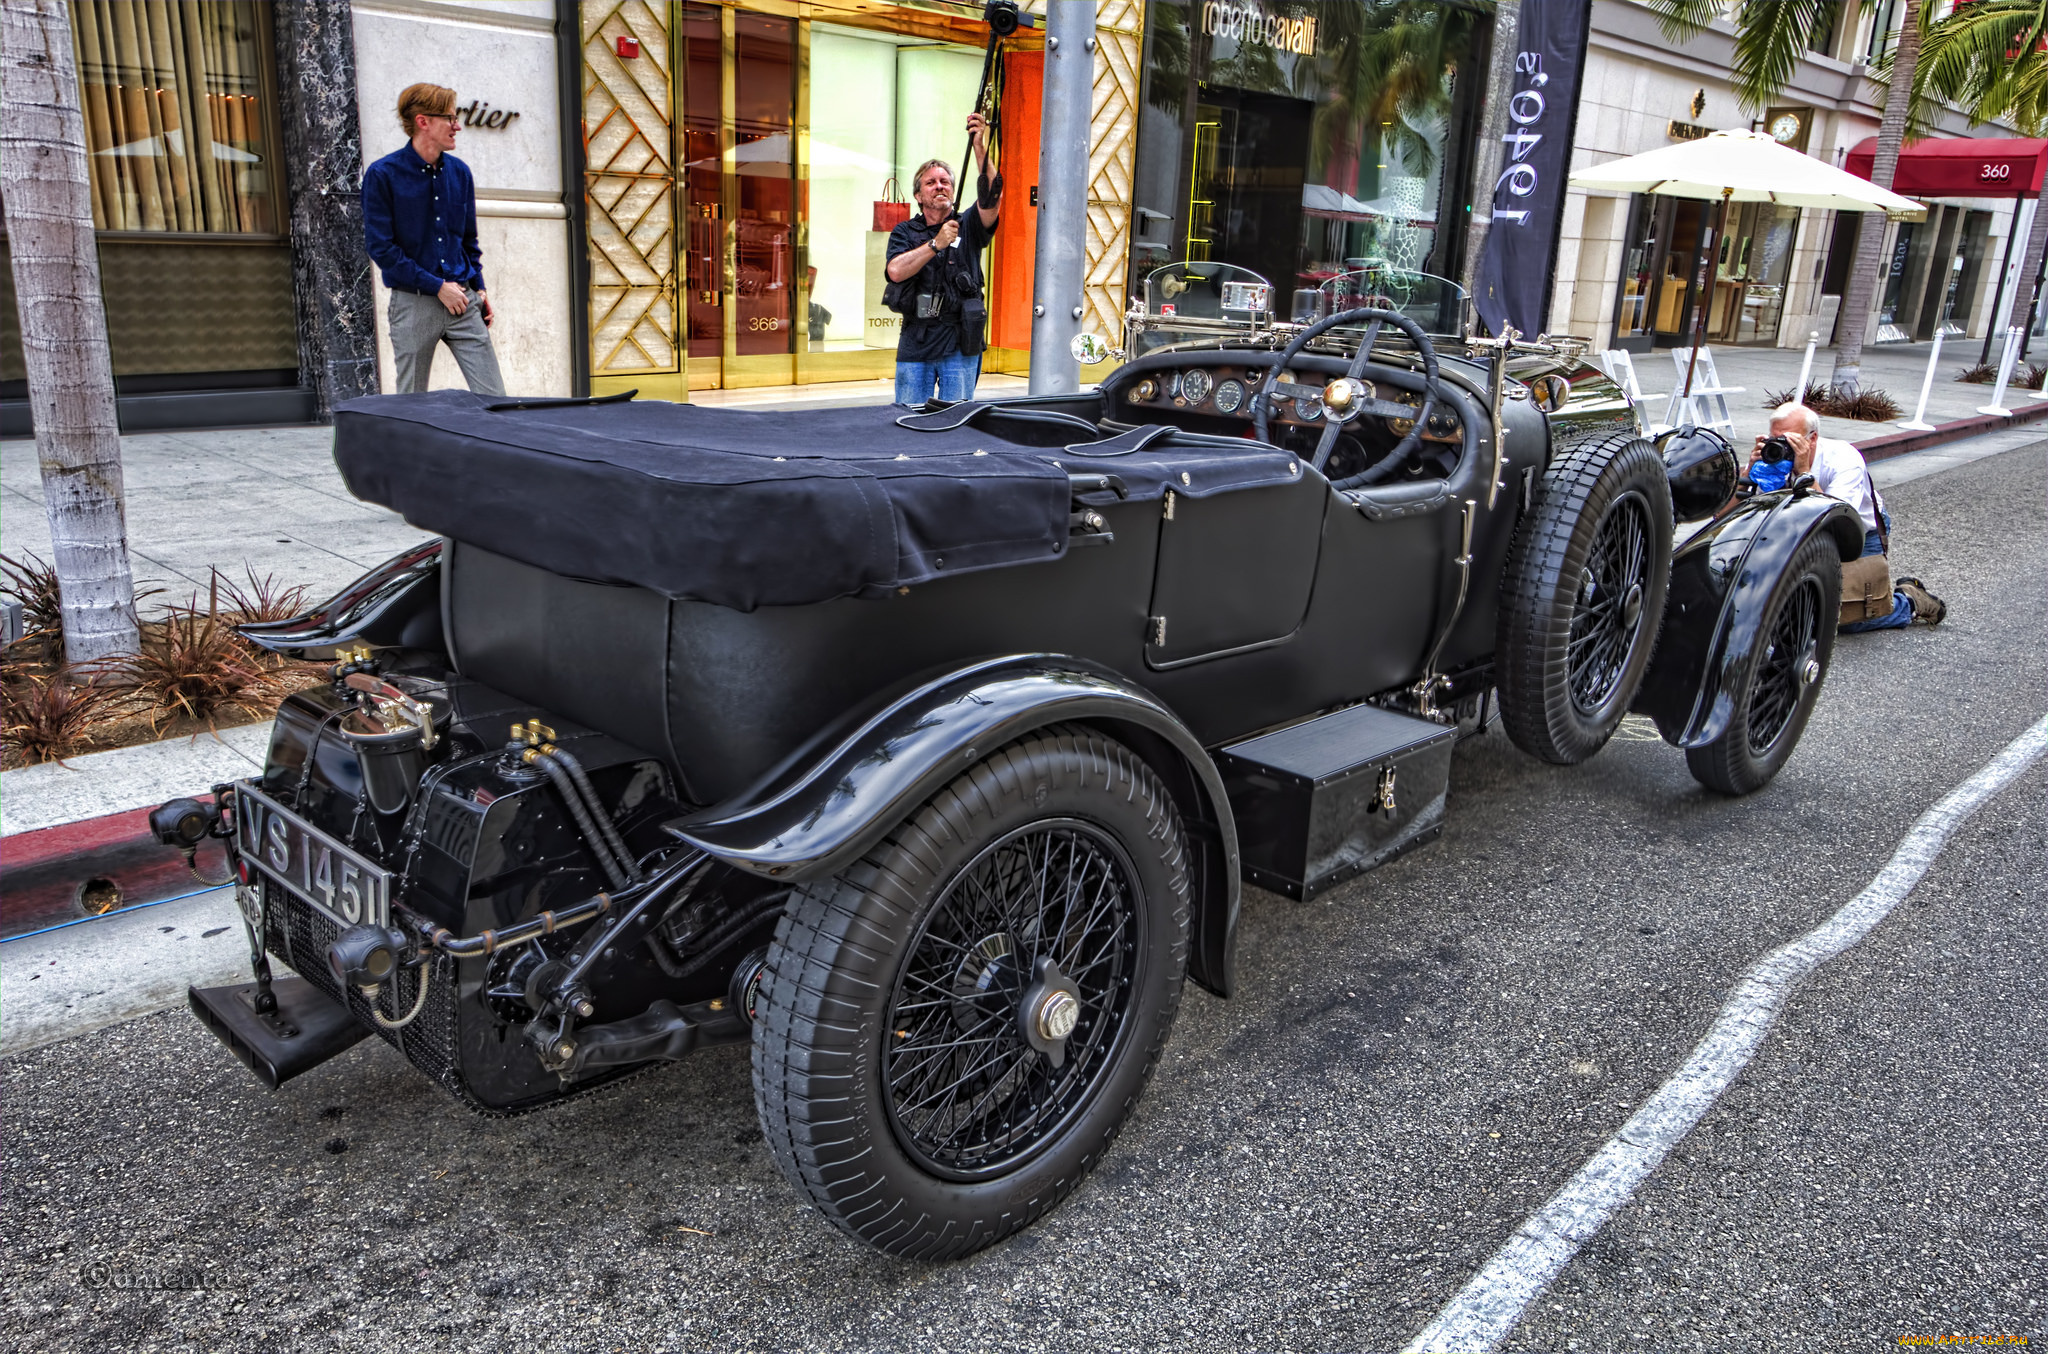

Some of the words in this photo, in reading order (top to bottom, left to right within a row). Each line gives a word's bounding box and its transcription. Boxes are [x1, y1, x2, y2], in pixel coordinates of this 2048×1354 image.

[1202, 0, 1262, 45] roberto
[1265, 14, 1316, 55] cavalli
[456, 100, 520, 130] rtier
[1981, 164, 2010, 178] 360
[749, 317, 779, 331] 366
[868, 317, 896, 328] TORY
[243, 794, 289, 873] VS
[302, 832, 375, 925] 1451
[241, 891, 257, 922] GB
